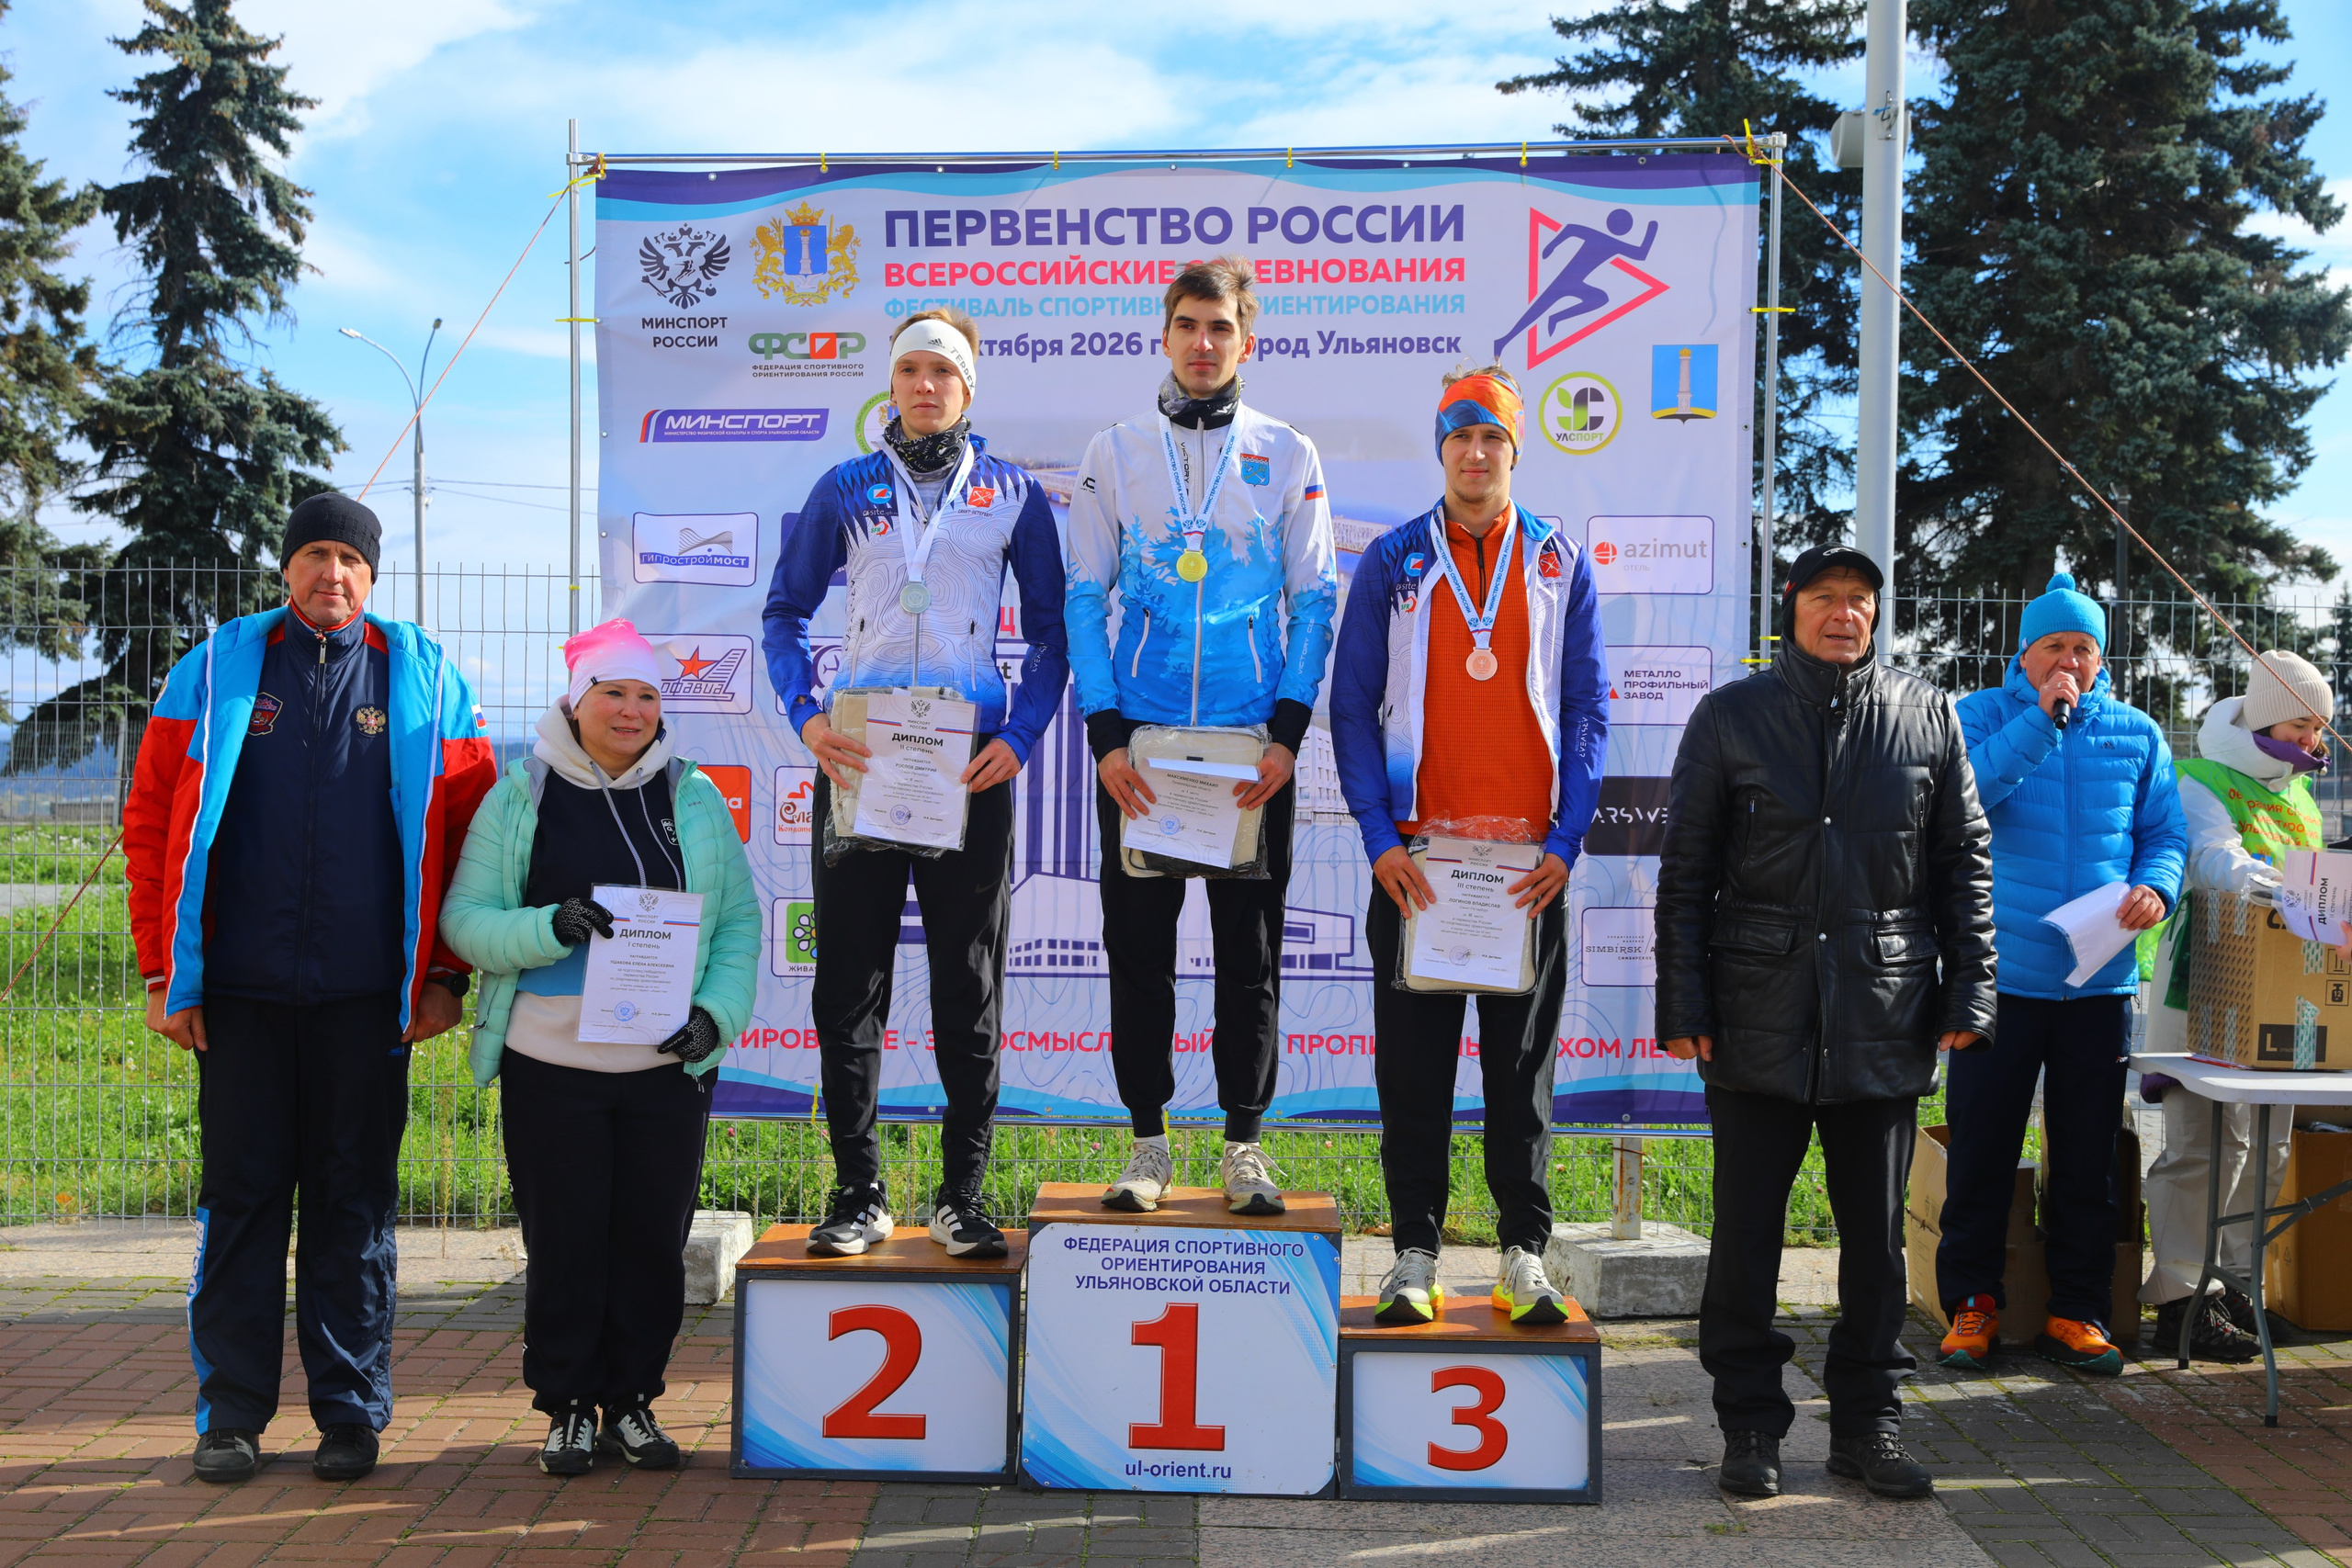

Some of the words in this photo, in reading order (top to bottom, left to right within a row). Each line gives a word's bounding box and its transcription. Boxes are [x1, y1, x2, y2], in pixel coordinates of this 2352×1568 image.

[885, 206, 1233, 248] ПЕРВЕНСТВО
[1247, 204, 1464, 244] РОССИИ
[884, 254, 1176, 287] ВСЕРОССИЙСКИЕ
[641, 317, 729, 329] МИНСПОРТ
[652, 335, 718, 348] РОССИИ
[1070, 332, 1144, 356] 2026
[1316, 330, 1462, 355] Ульяновск
[949, 345, 975, 390] TERREX
[664, 414, 821, 430] МИНСПОРТ
[1555, 433, 1605, 441] УЛСПОРТ
[1181, 442, 1190, 483] VICTORY
[1164, 432, 1178, 472] МИНИСТЕРСТВО
[1173, 472, 1182, 492] СПОРТА
[1178, 492, 1188, 514] РОССИИ
[1203, 475, 1220, 514] МИНИСТЕРСТВО
[1217, 456, 1229, 475] СПОРТА
[1225, 435, 1236, 456] РОССИИ
[1623, 538, 1708, 558] azimut
[1435, 536, 1453, 573] МИНИСТЕРСТВО
[1450, 572, 1462, 592] СПОРТА
[1459, 592, 1472, 614] РОССИИ
[1488, 572, 1503, 612] МИНИСТЕРСТВО
[1498, 554, 1508, 573] СПОРТА
[1297, 637, 1309, 675] VICTORY
[1623, 679, 1709, 690] ПРОФИЛЬНЫЙ
[1623, 692, 1664, 701] ЗАВОД
[891, 732, 944, 747] ДИПЛОМ
[906, 745, 933, 755] степень
[1451, 869, 1505, 885] ДИПЛОМ
[1465, 884, 1495, 893] степень
[1472, 900, 1501, 908] ВЛАДИСЛАВ
[2318, 877, 2329, 925] ДИПЛОМ
[619, 928, 672, 941] ДИПЛОМ
[2266, 1032, 2278, 1052] L
[1063, 1237, 1170, 1255] ФЕДЕРАЦИЯ
[1174, 1240, 1305, 1258] СПОРТИВНОГО
[1101, 1258, 1266, 1275] ОРИЕНТИРОВАНИЯ
[1075, 1275, 1204, 1292] УЛЬЯНОВСКОЙ
[1208, 1279, 1291, 1295] ОБЛАСТИ
[821, 1303, 927, 1441] 2
[1128, 1302, 1226, 1452] 1
[1426, 1364, 1510, 1472] 3
[1125, 1461, 1232, 1479] ul-orient.ru
